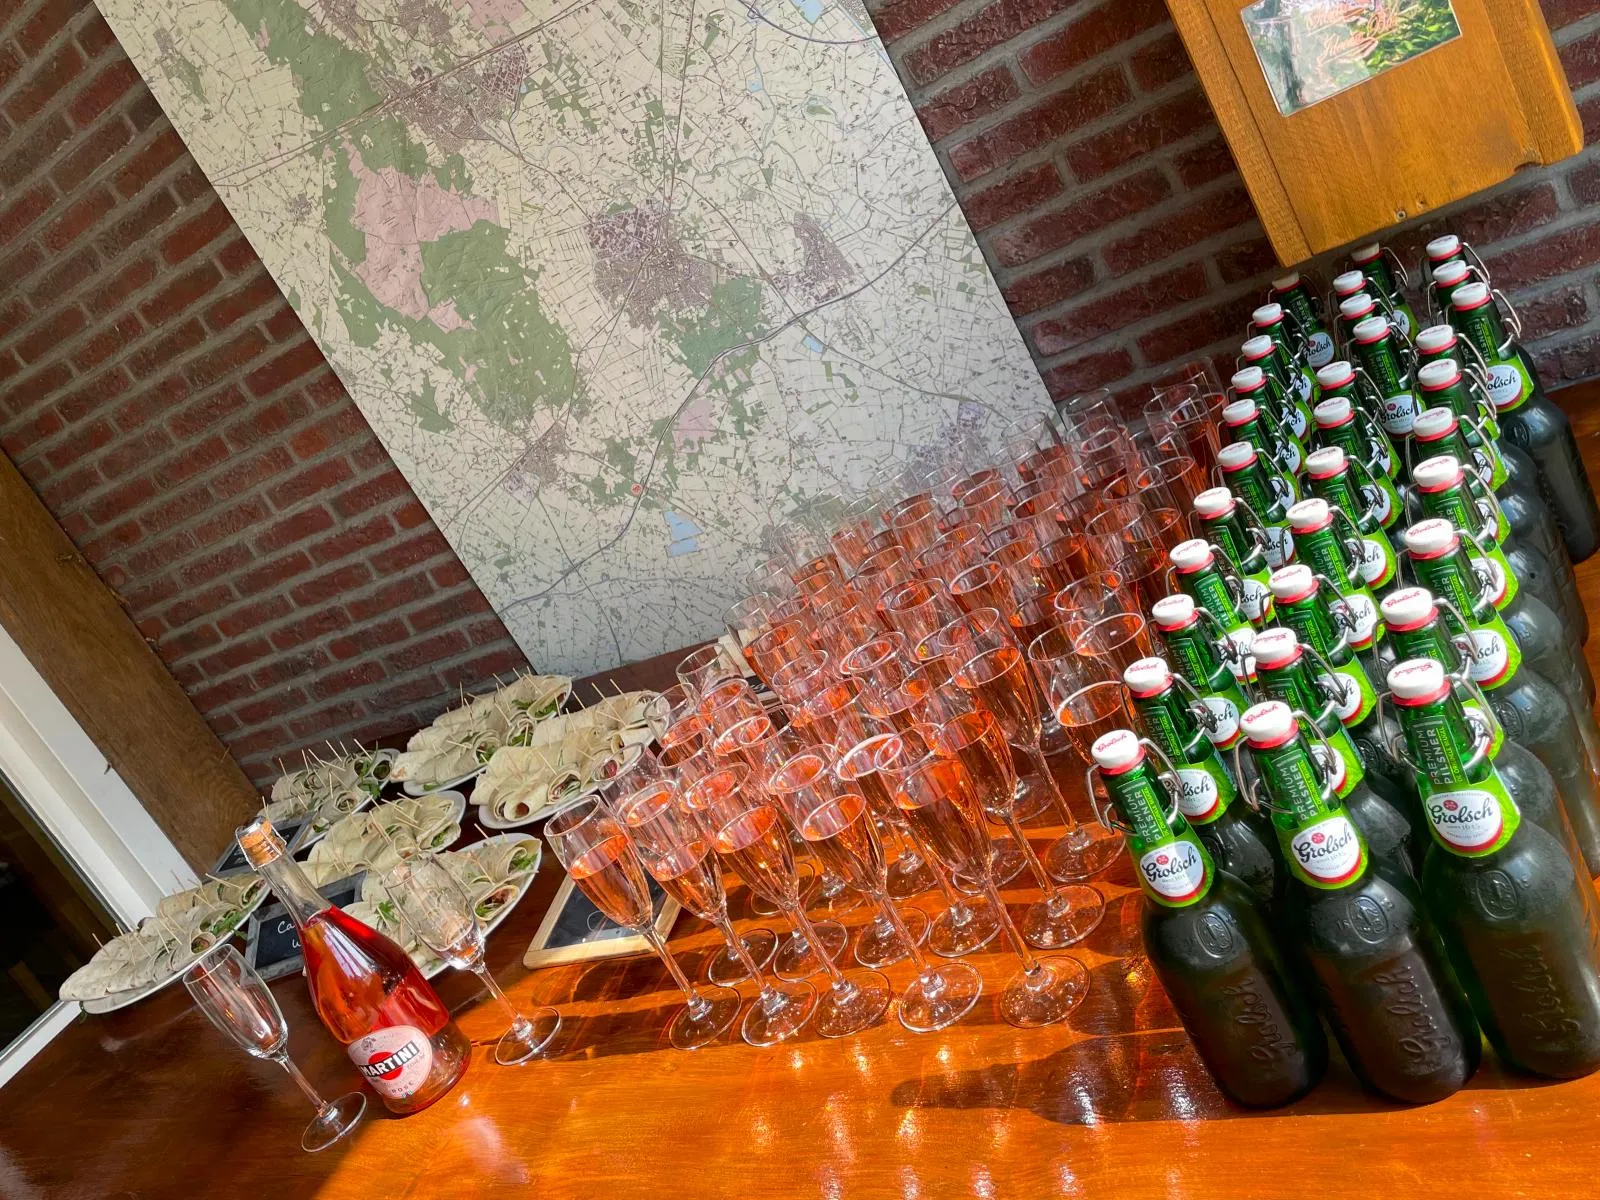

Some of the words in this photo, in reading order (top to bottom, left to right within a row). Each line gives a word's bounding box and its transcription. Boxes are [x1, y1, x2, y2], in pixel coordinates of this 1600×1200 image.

[1208, 584, 1231, 628] PILSNER
[1416, 729, 1444, 785] PREMIUM
[1426, 727, 1454, 784] PILSNER
[1281, 767, 1309, 821] PREMIUM
[1290, 764, 1317, 817] PILSNER
[1429, 797, 1493, 825] Grolsch
[1123, 793, 1153, 843] PREMIUM
[1135, 791, 1161, 841] PILSNER
[1141, 847, 1197, 883] Grolsch
[1293, 822, 1351, 864] Grolsch
[361, 1042, 418, 1077] MARTINI
